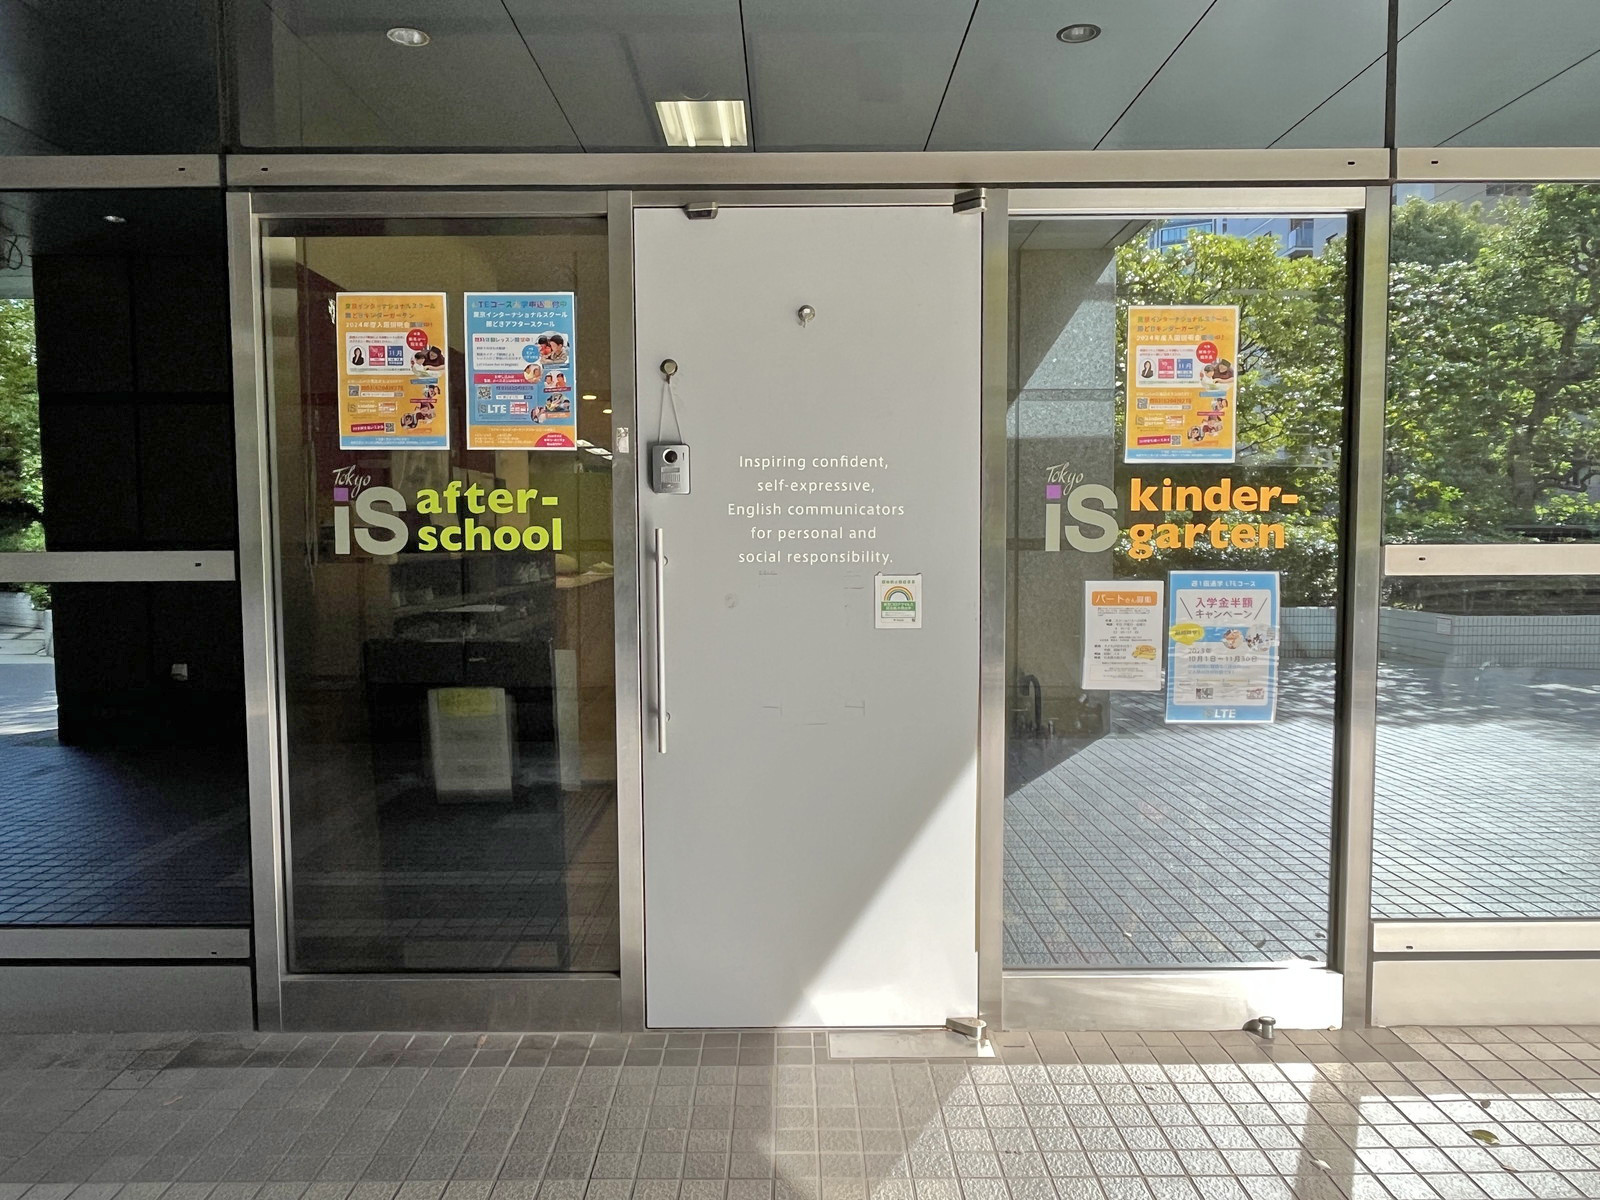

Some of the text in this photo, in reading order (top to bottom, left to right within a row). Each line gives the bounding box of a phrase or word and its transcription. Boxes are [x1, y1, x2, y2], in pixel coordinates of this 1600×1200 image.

[473, 311, 568, 319] 東京インターナショナルスクール
[487, 404, 507, 414] LTE
[739, 455, 889, 471] Inspiring confident,
[333, 464, 372, 498] Tokyo
[1046, 461, 1084, 496] Tokyo
[757, 479, 875, 494] self-expressive,
[416, 480, 559, 514] after-
[1129, 477, 1299, 512] kinder-
[728, 502, 905, 518] English communicators
[416, 517, 563, 552] school
[750, 526, 877, 541] for personal and
[1128, 517, 1285, 559] garten
[738, 550, 893, 565] social responsibility.
[1195, 597, 1254, 609] 入学金半額
[1195, 609, 1253, 619] キャンペーン
[1214, 709, 1237, 719] LTE
